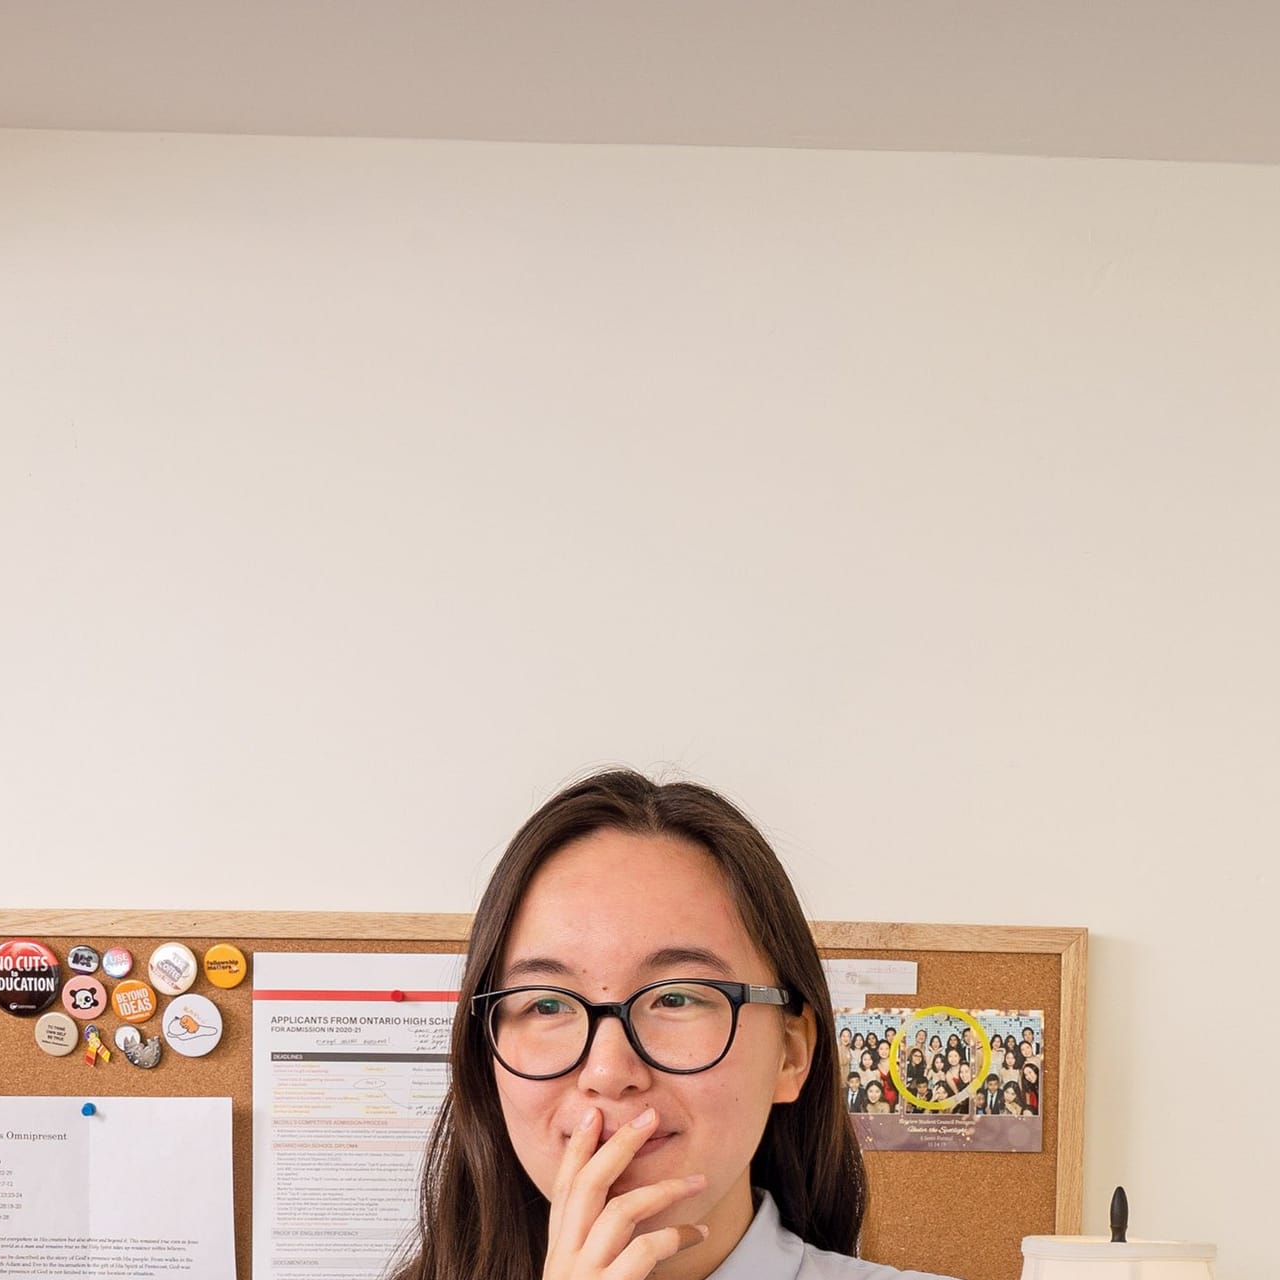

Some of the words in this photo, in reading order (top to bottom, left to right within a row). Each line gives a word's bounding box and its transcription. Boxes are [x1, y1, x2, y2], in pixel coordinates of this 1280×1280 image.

[17, 955, 48, 972] CUTS
[10, 970, 19, 978] to
[116, 988, 148, 1003] BEYOND
[119, 999, 153, 1016] IDEAS
[271, 1016, 329, 1025] APPLICANTS
[330, 1016, 358, 1025] FROM
[359, 1017, 401, 1025] ONTARIO
[403, 1017, 427, 1025] HIGH
[6, 1131, 67, 1141] Omnipresent
